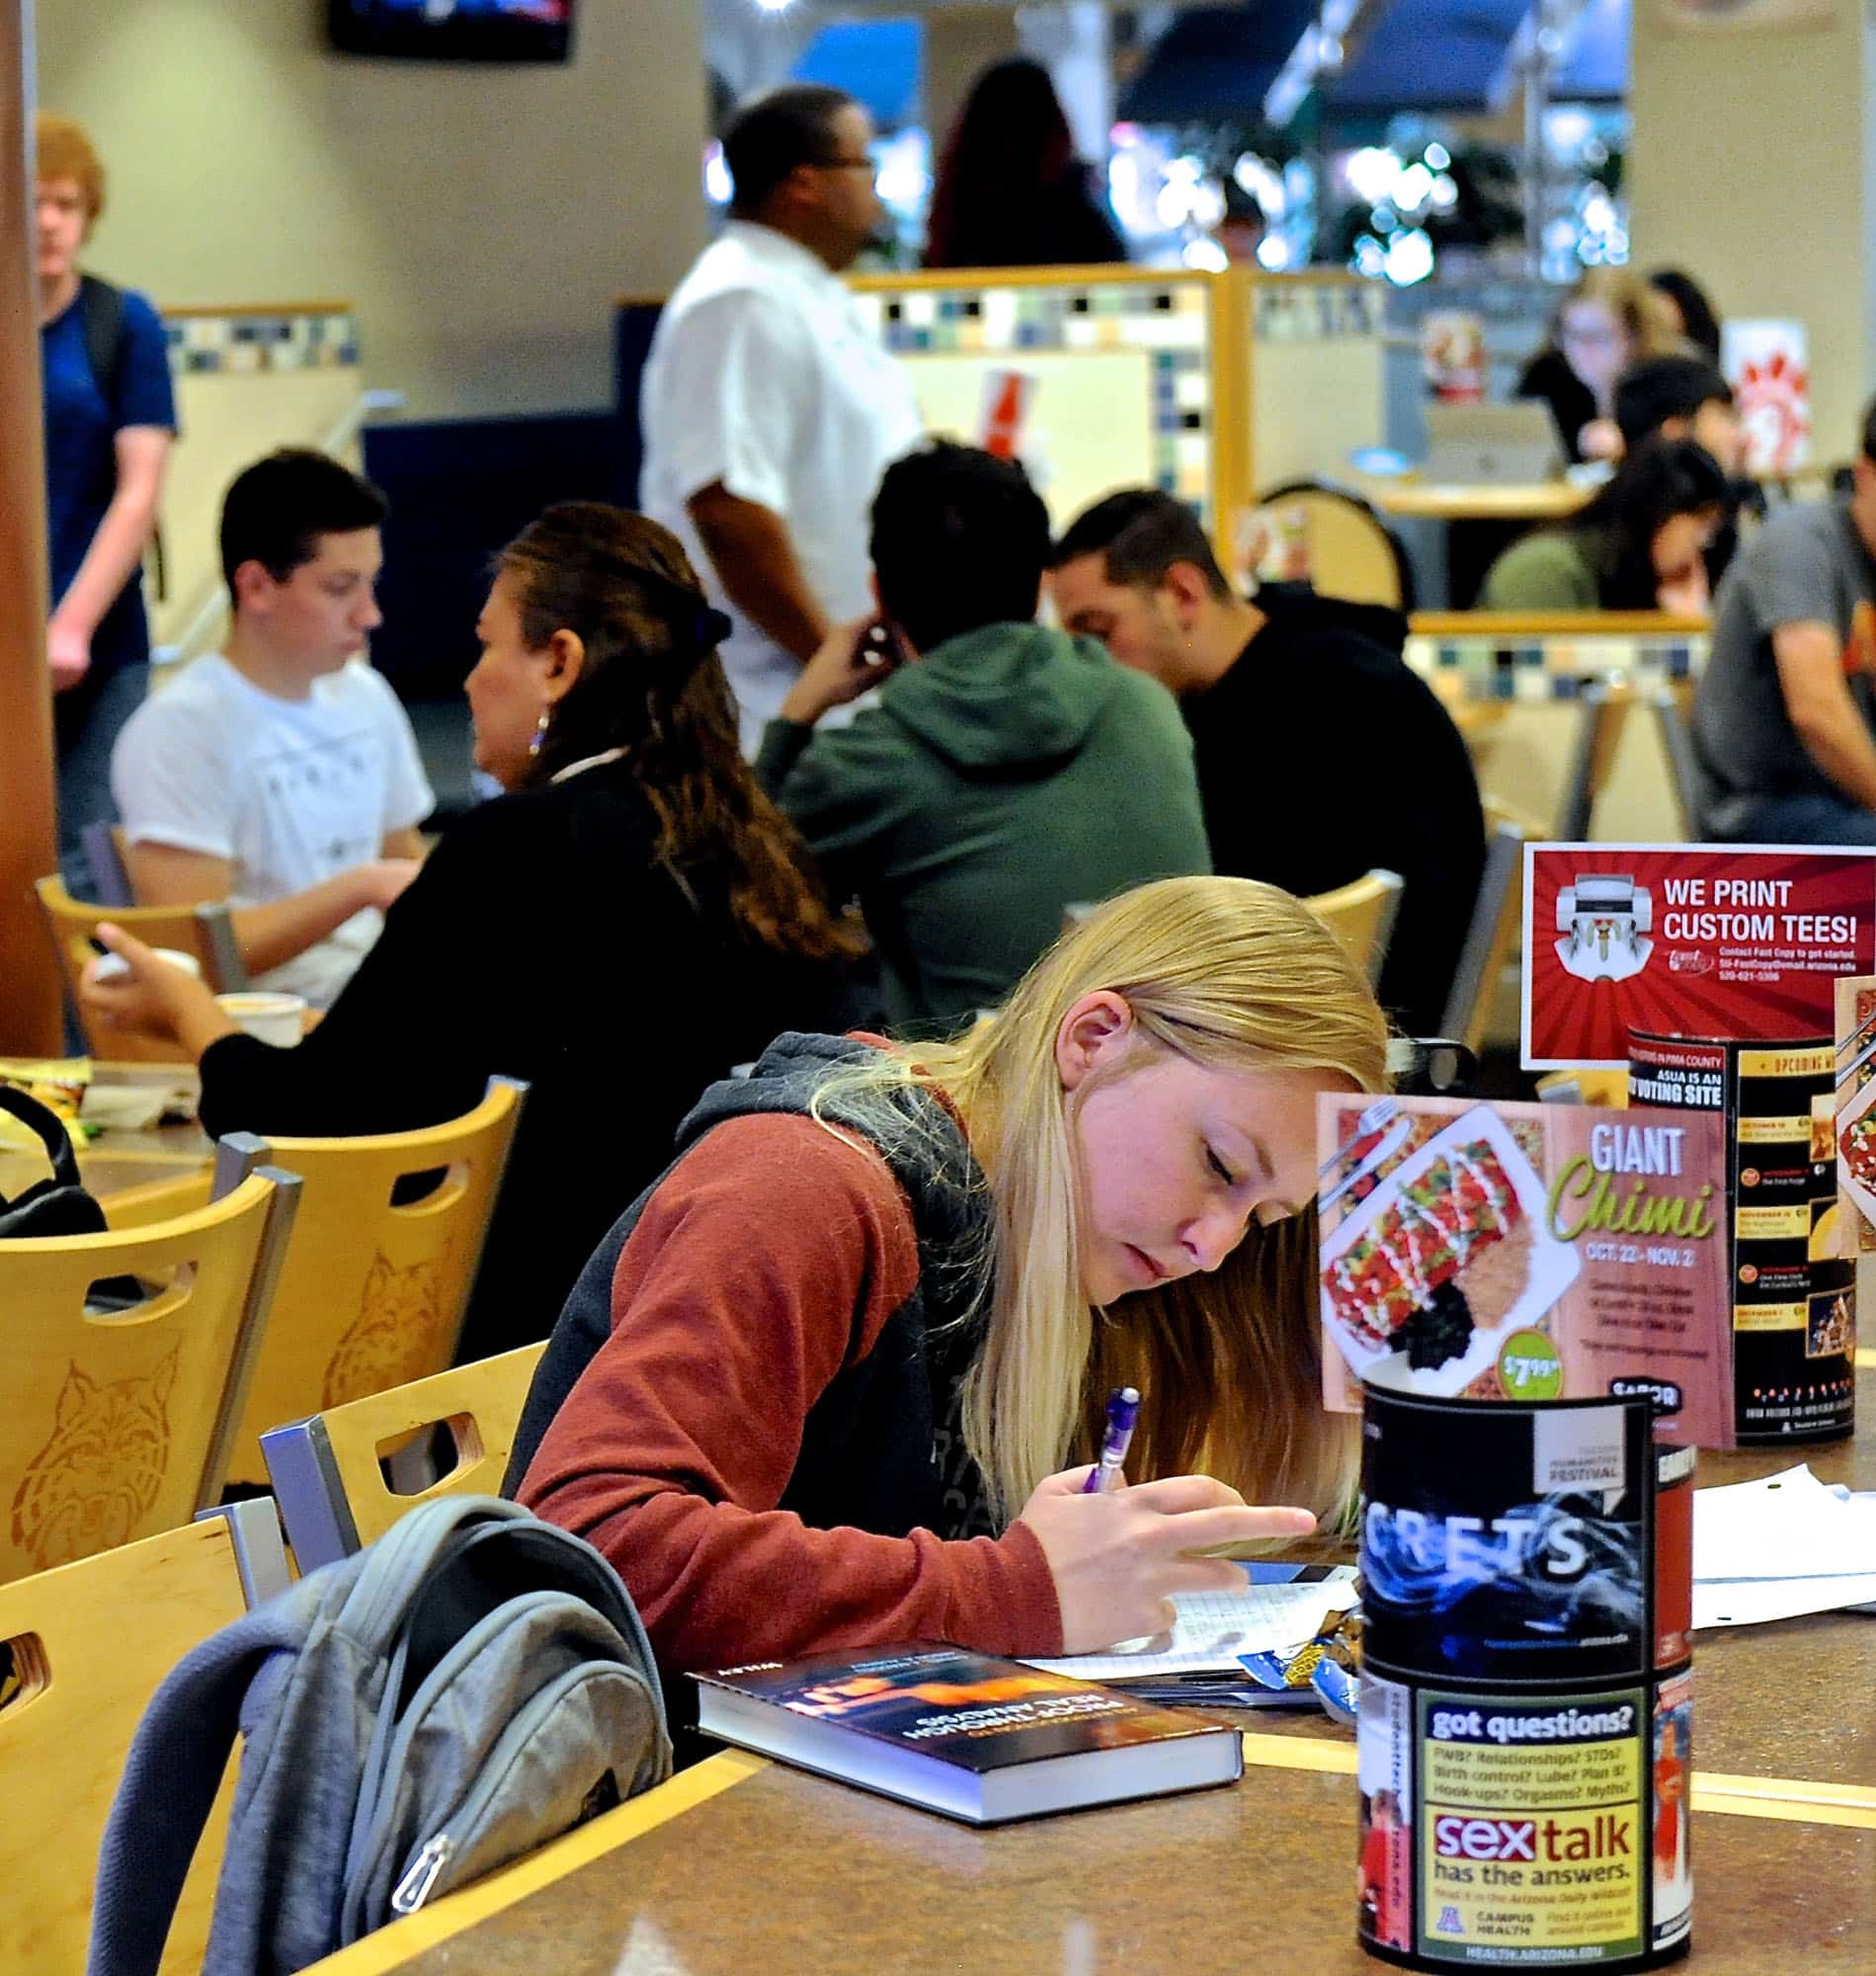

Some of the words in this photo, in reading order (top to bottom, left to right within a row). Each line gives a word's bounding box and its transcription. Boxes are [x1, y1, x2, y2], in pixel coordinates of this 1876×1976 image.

[1664, 879, 1705, 906] WE
[1714, 879, 1793, 908] PRINT
[1664, 913, 1774, 942] CUSTOM
[1782, 914, 1857, 945] TEES!
[1685, 1055, 1722, 1068] COUNTY
[1658, 1069, 1685, 1084] ASUA
[1688, 1072, 1699, 1084] IS
[1702, 1073, 1722, 1086] AN
[1637, 1078, 1682, 1104] VOTING
[1684, 1084, 1722, 1106] SITE
[1591, 1122, 1687, 1177] GIANT
[1545, 1153, 1717, 1243] Chimi
[1549, 1466, 1618, 1481] FESTIVAL
[916, 1701, 1034, 1727] ANALYSIS
[1037, 1699, 1125, 1719] PROOF
[902, 1713, 1037, 1739] THROUGH
[1432, 1710, 1483, 1739] got
[1486, 1704, 1634, 1744] questions?
[1476, 1748, 1581, 1766] Relationships?
[1585, 1746, 1621, 1763] STDs?
[1433, 1764, 1467, 1780] Birth
[1472, 1767, 1531, 1784] control?
[1535, 1767, 1578, 1783] Lube?
[1581, 1766, 1609, 1780] Plan
[1433, 1782, 1509, 1801] Hook-ups?
[1512, 1784, 1582, 1804] Orgasms?
[1586, 1781, 1632, 1800] Myths?
[1435, 1817, 1535, 1860] sex
[1543, 1815, 1630, 1862] talk
[1433, 1861, 1474, 1884] has
[1482, 1864, 1522, 1886] the
[1532, 1862, 1631, 1886] answers.
[1476, 1911, 1534, 1924] CAMPUS
[1477, 1926, 1531, 1937] HEALTH
[1466, 1946, 1603, 1962] HEALTH.ARIZONA.EDU
